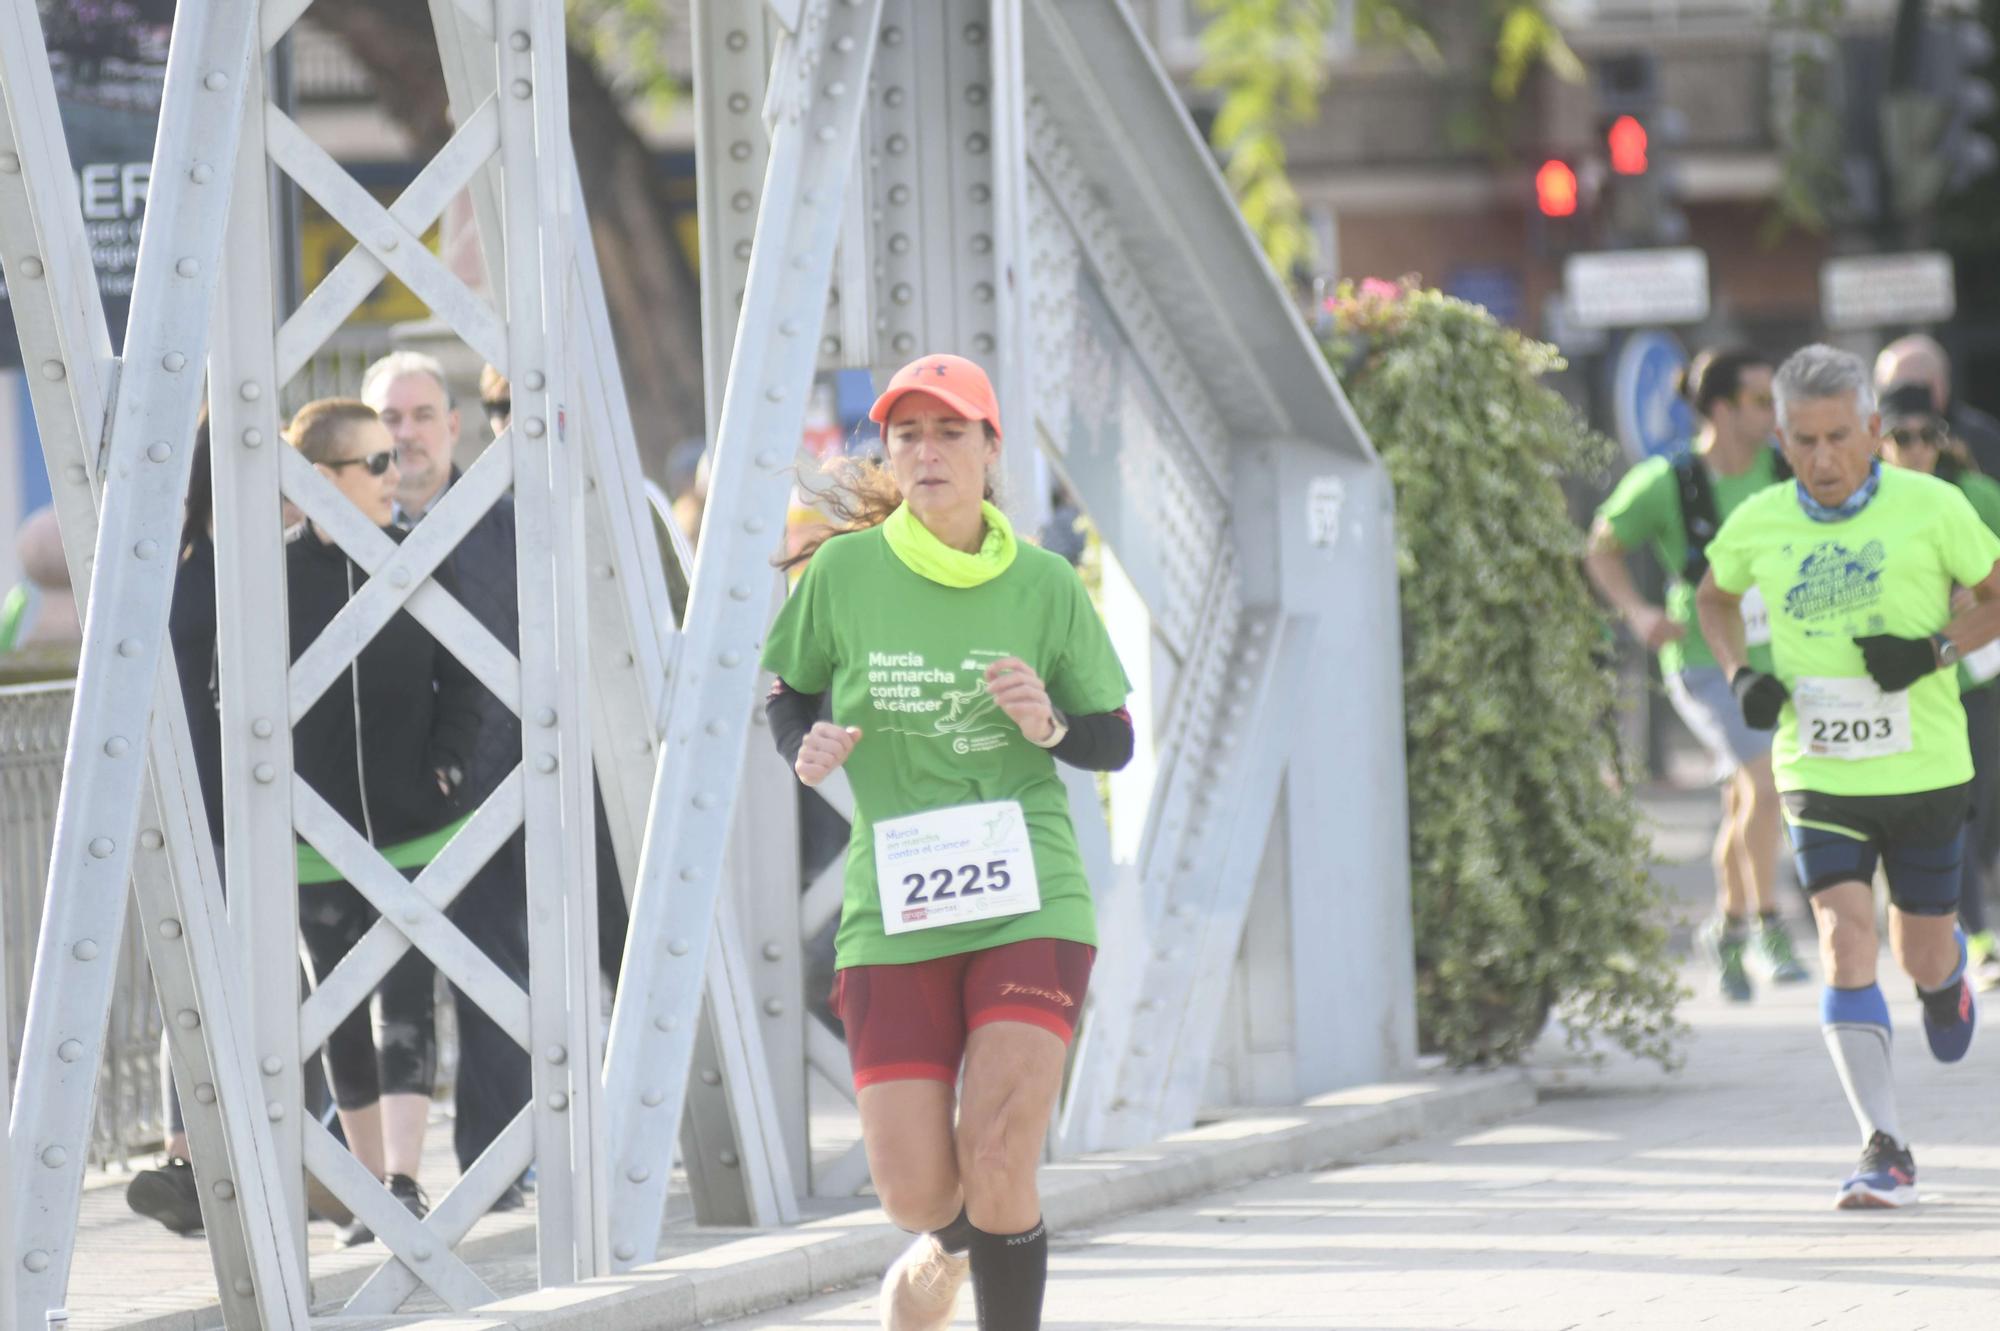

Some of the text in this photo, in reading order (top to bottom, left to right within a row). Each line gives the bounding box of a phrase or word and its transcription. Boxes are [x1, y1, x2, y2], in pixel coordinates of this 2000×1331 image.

[868, 652, 923, 667] Murcia
[868, 667, 955, 684] en marcha
[870, 684, 921, 698] contra
[873, 699, 943, 713] el cáncer
[1811, 717, 1892, 743] 2203
[902, 859, 1012, 906] 2225
